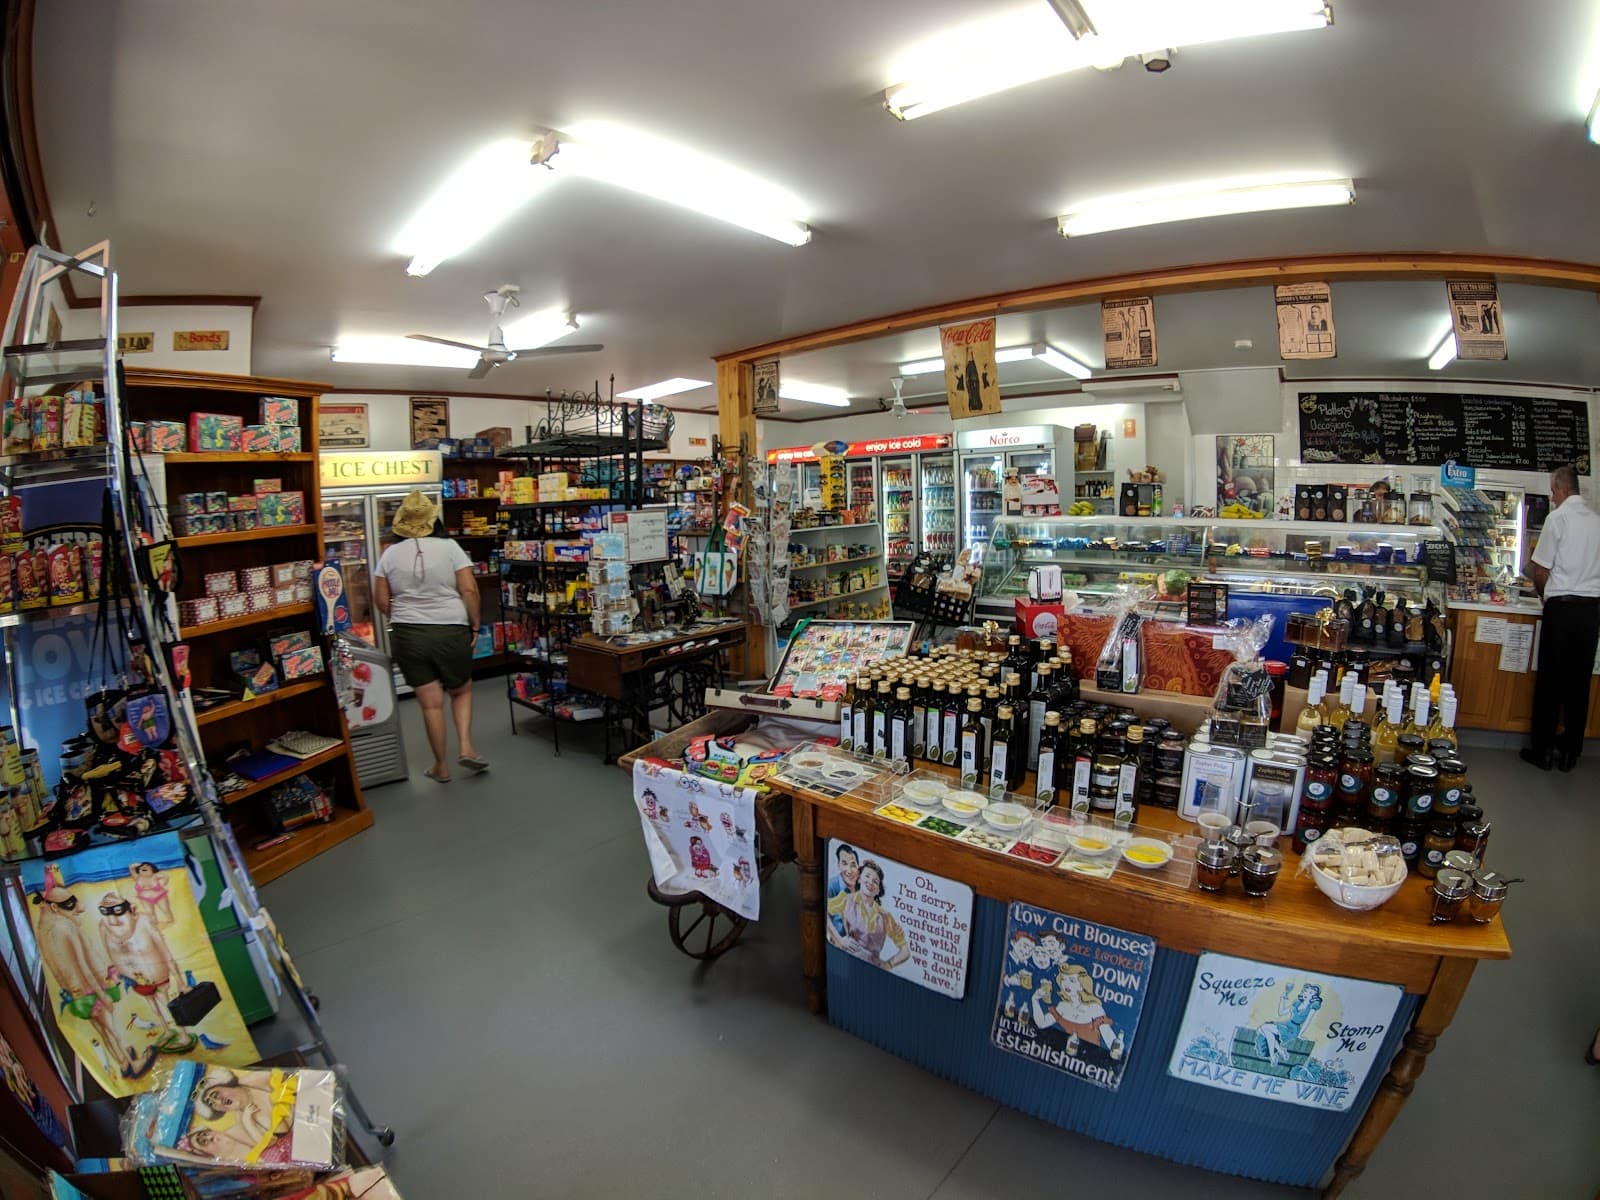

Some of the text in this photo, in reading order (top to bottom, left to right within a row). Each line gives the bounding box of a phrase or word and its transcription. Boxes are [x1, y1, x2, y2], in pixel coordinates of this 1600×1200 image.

[1318, 402, 1351, 419] Platters
[1310, 418, 1355, 432] Occasions
[865, 440, 888, 454] enjoy
[888, 438, 901, 451] ice
[902, 437, 921, 449] cold
[989, 434, 1020, 446] Norco
[332, 459, 433, 478] ICE CHEST
[914, 876, 939, 894] Oh.
[899, 883, 958, 914] I'm sorry.
[892, 895, 968, 932] You must be
[899, 914, 962, 946] confusing
[908, 930, 927, 943] me
[1014, 904, 1150, 957] Low Cut Blouses
[909, 940, 964, 970] the maid
[1069, 942, 1091, 958] are
[912, 955, 962, 982] we don't
[1091, 962, 1141, 992] DOWN
[922, 969, 955, 991] have.
[1199, 971, 1277, 995] Squeeze
[1094, 983, 1135, 1009] Upon
[1217, 990, 1249, 1008] Me
[1012, 1018, 1036, 1038] this
[1326, 1021, 1385, 1040] Stomp
[1336, 1036, 1368, 1053] Me
[996, 1028, 1118, 1089] Establishment
[1178, 1058, 1351, 1109] MAKE ME WINE
